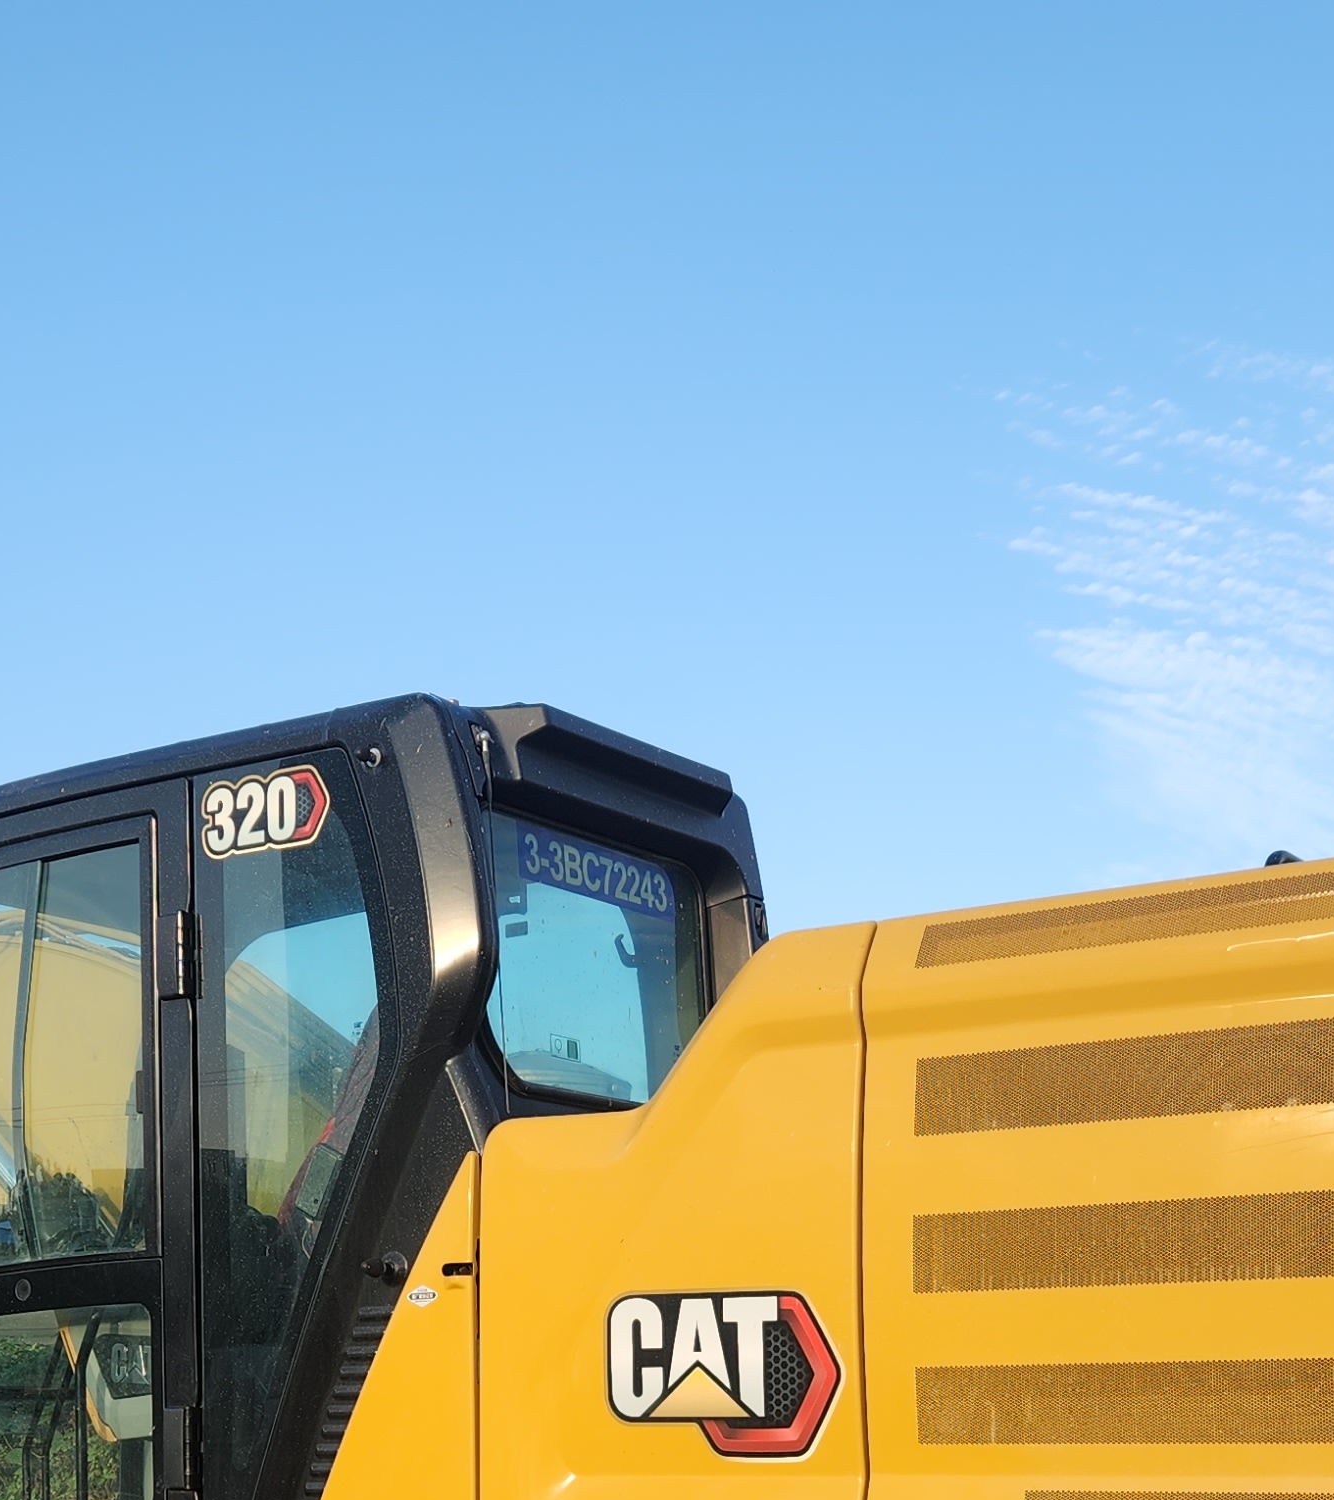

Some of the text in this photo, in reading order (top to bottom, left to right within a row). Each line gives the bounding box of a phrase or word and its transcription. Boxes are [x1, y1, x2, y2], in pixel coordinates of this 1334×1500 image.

[206, 775, 297, 852] 320
[524, 832, 668, 912] 3-3BC72243
[610, 1296, 778, 1418] CAT
